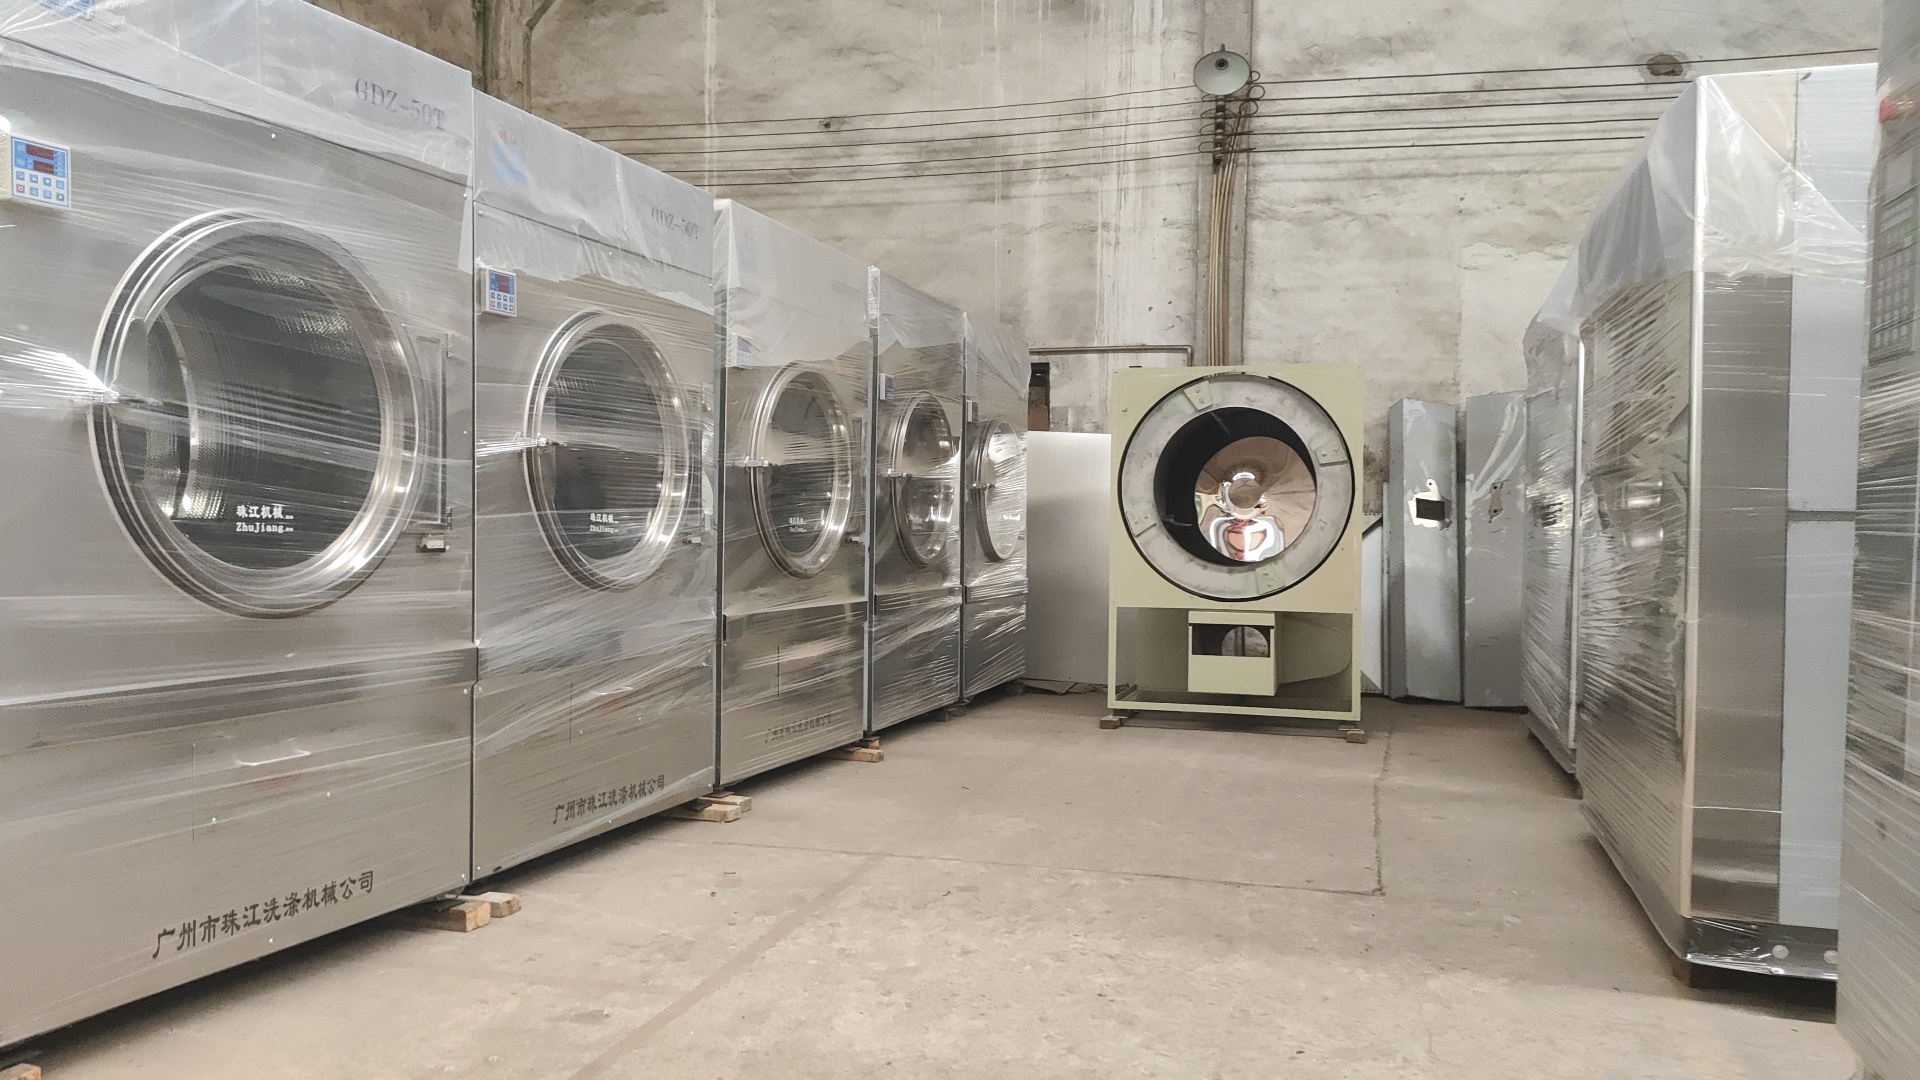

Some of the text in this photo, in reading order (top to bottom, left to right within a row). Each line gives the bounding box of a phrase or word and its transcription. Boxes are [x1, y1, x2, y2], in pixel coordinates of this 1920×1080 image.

[355, 78, 445, 131] GDZ-50T
[236, 521, 284, 533] ZhuJiang
[152, 870, 374, 959] 广州市珠江洗涤机械公司
